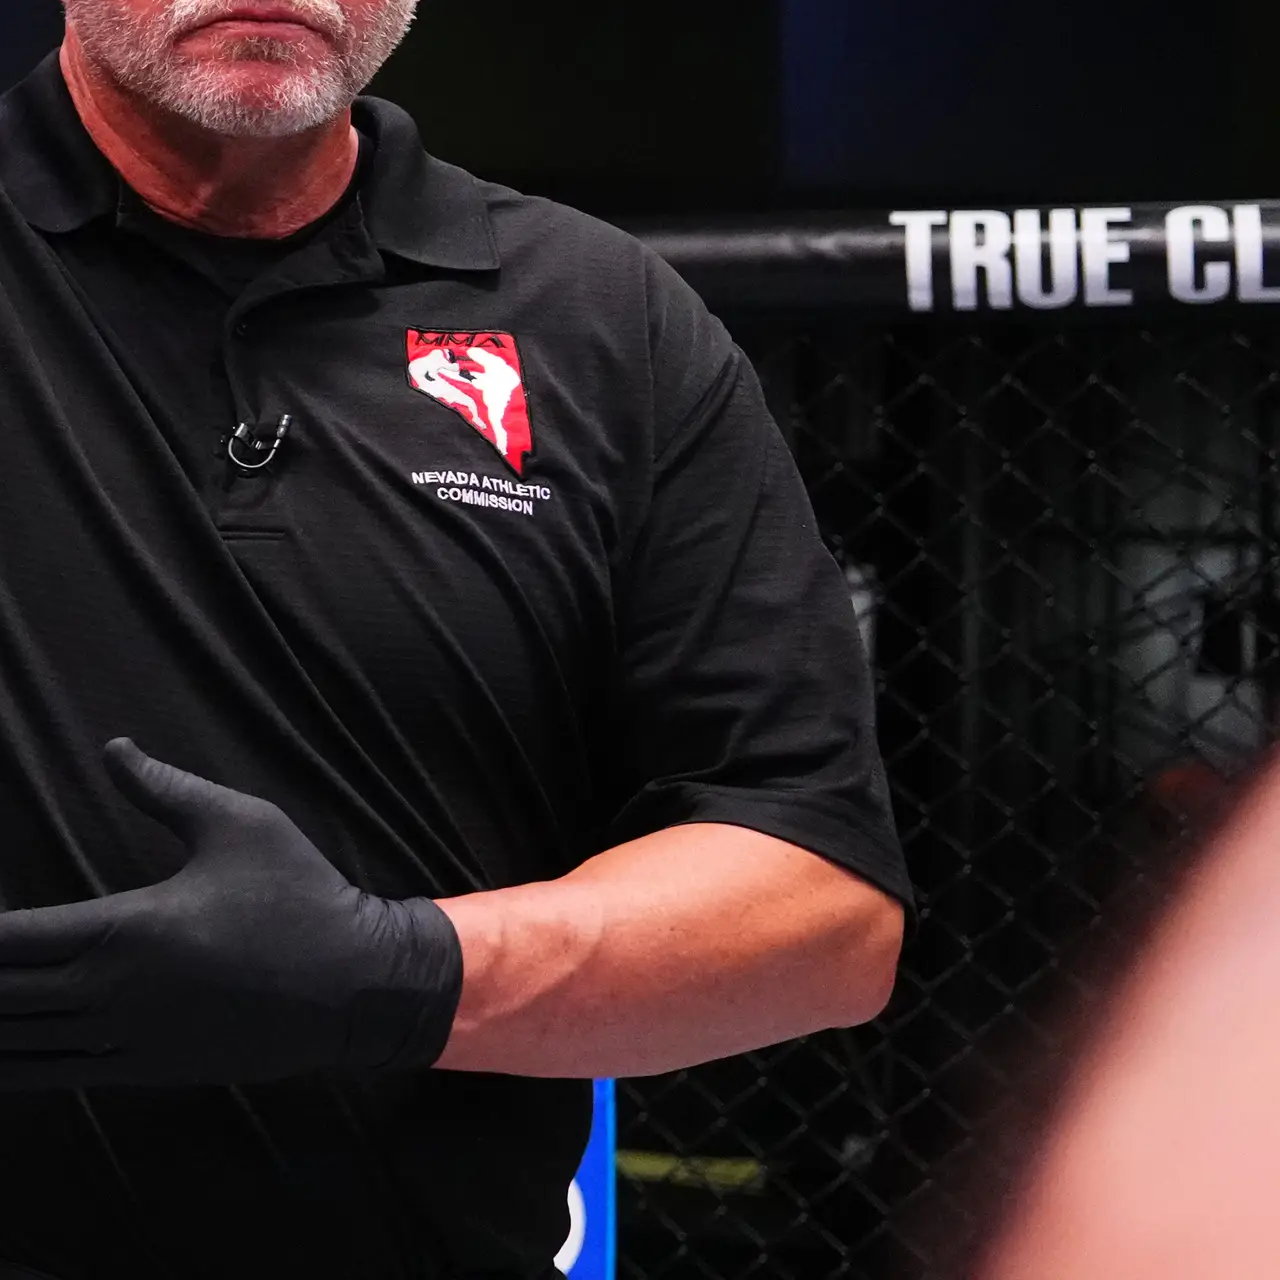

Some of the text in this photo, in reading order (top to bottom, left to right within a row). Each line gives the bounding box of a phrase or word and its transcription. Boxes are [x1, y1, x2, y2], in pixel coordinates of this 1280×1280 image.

[889, 207, 1134, 311] TRUE
[415, 333, 506, 348] MMA
[411, 470, 551, 500] NEVADA ATHLETIC
[437, 487, 533, 516] COMMISSION
